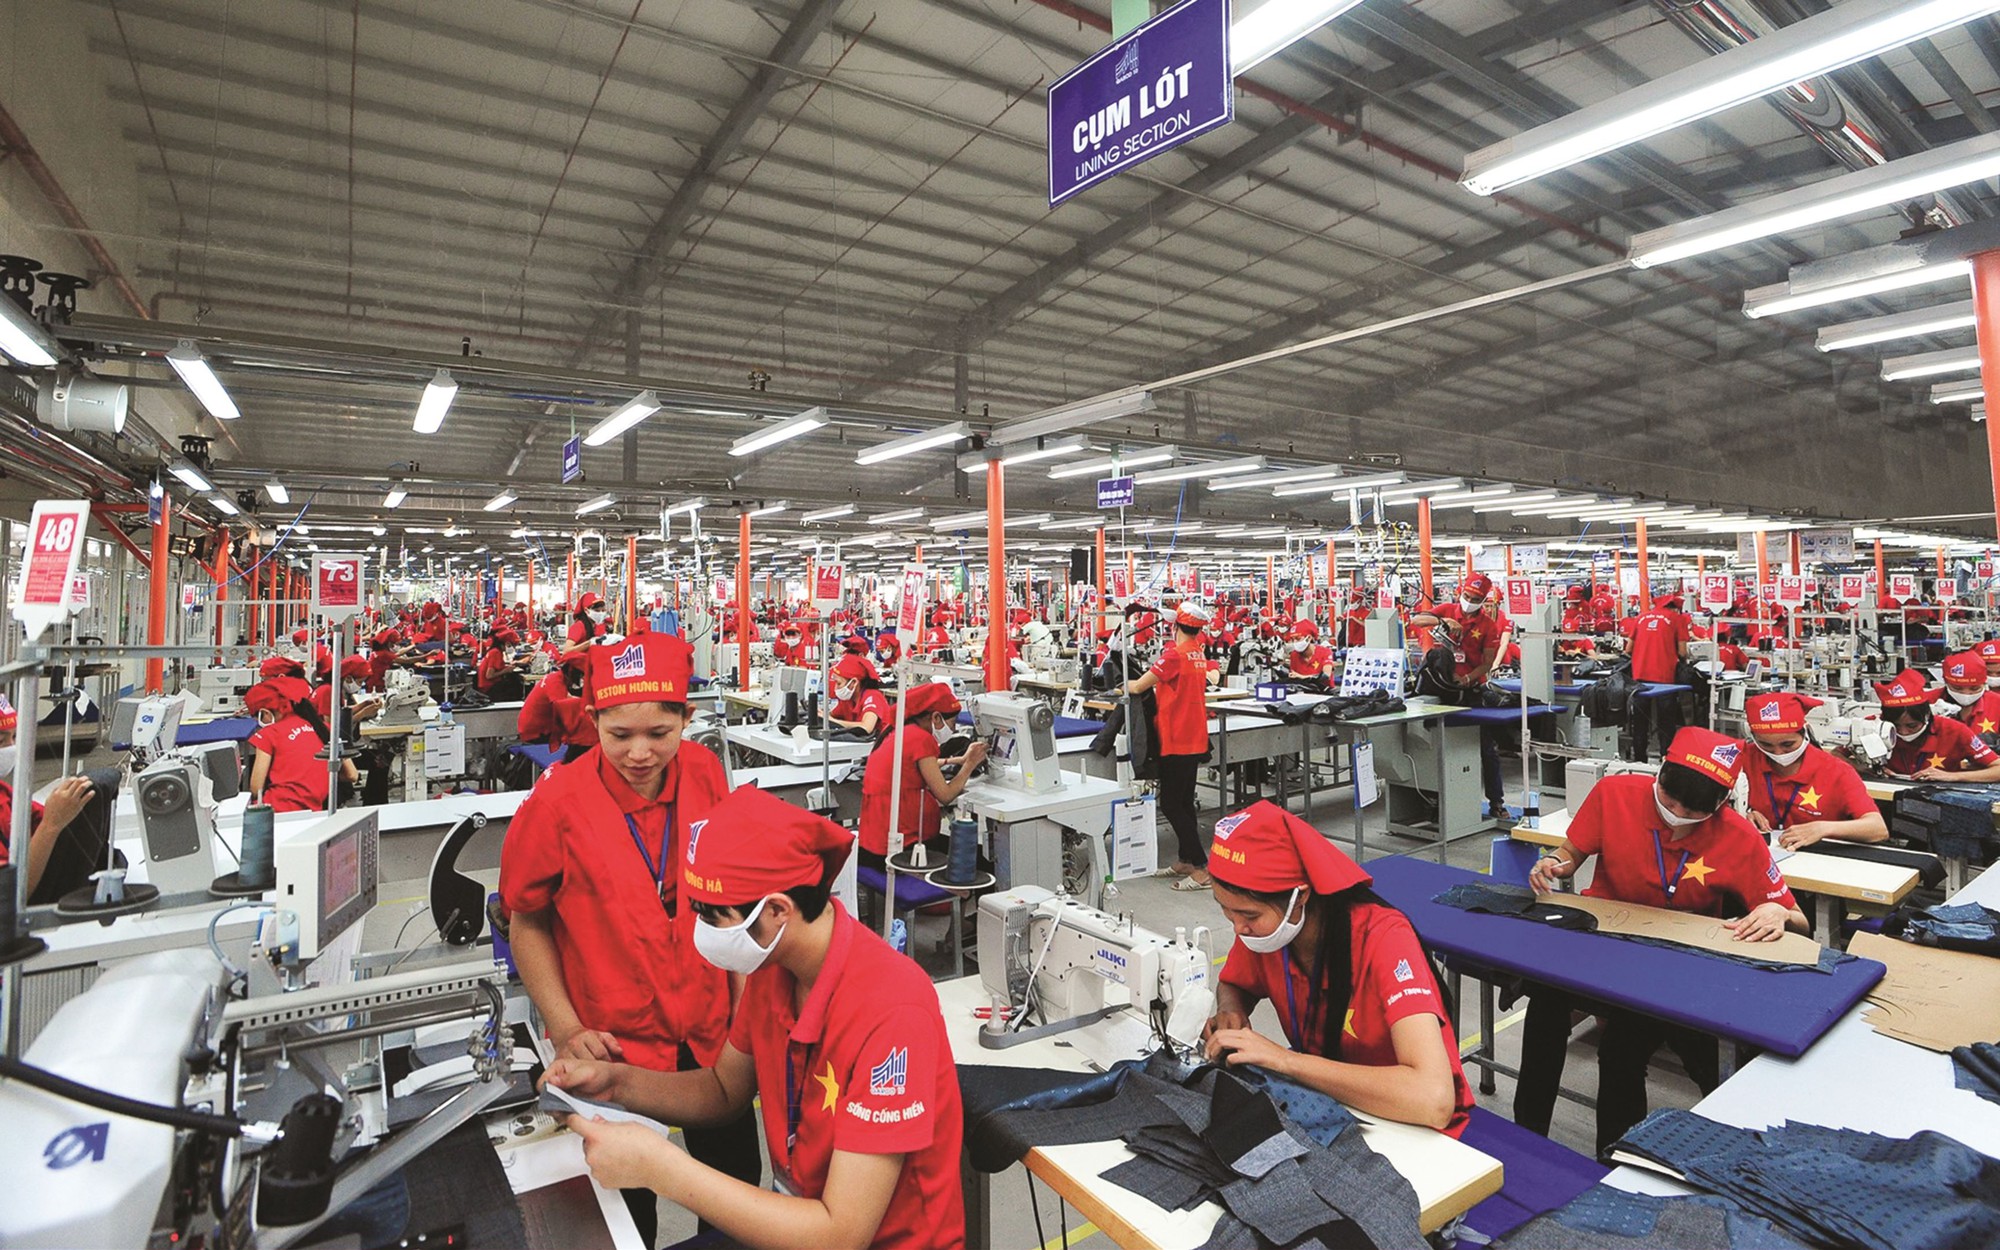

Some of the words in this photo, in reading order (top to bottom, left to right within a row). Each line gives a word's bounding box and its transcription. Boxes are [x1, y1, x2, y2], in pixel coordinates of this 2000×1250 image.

[1072, 94, 1131, 153] CỤM
[1139, 61, 1193, 119] LÓT
[1075, 146, 1121, 181] LINING
[1123, 109, 1191, 156] SECTION
[39, 517, 75, 552] 48
[320, 562, 355, 582] 73
[821, 565, 840, 579] 74
[1113, 570, 1126, 583] 75
[1511, 582, 1529, 595] 51
[1707, 577, 1726, 589] 54
[1783, 578, 1800, 587] 56
[1845, 578, 1861, 587] 57
[629, 680, 659, 693] HƯNG
[661, 679, 674, 692] HÀ
[1685, 753, 1717, 773] VESTON
[1231, 850, 1246, 865] HÀ
[706, 877, 723, 894] HÀ
[1097, 948, 1127, 968] JUKI
[893, 1074, 906, 1086] 10
[846, 1101, 872, 1122] SỐNG
[872, 1107, 901, 1124] CỐNG
[902, 1100, 925, 1121] HIẾN
